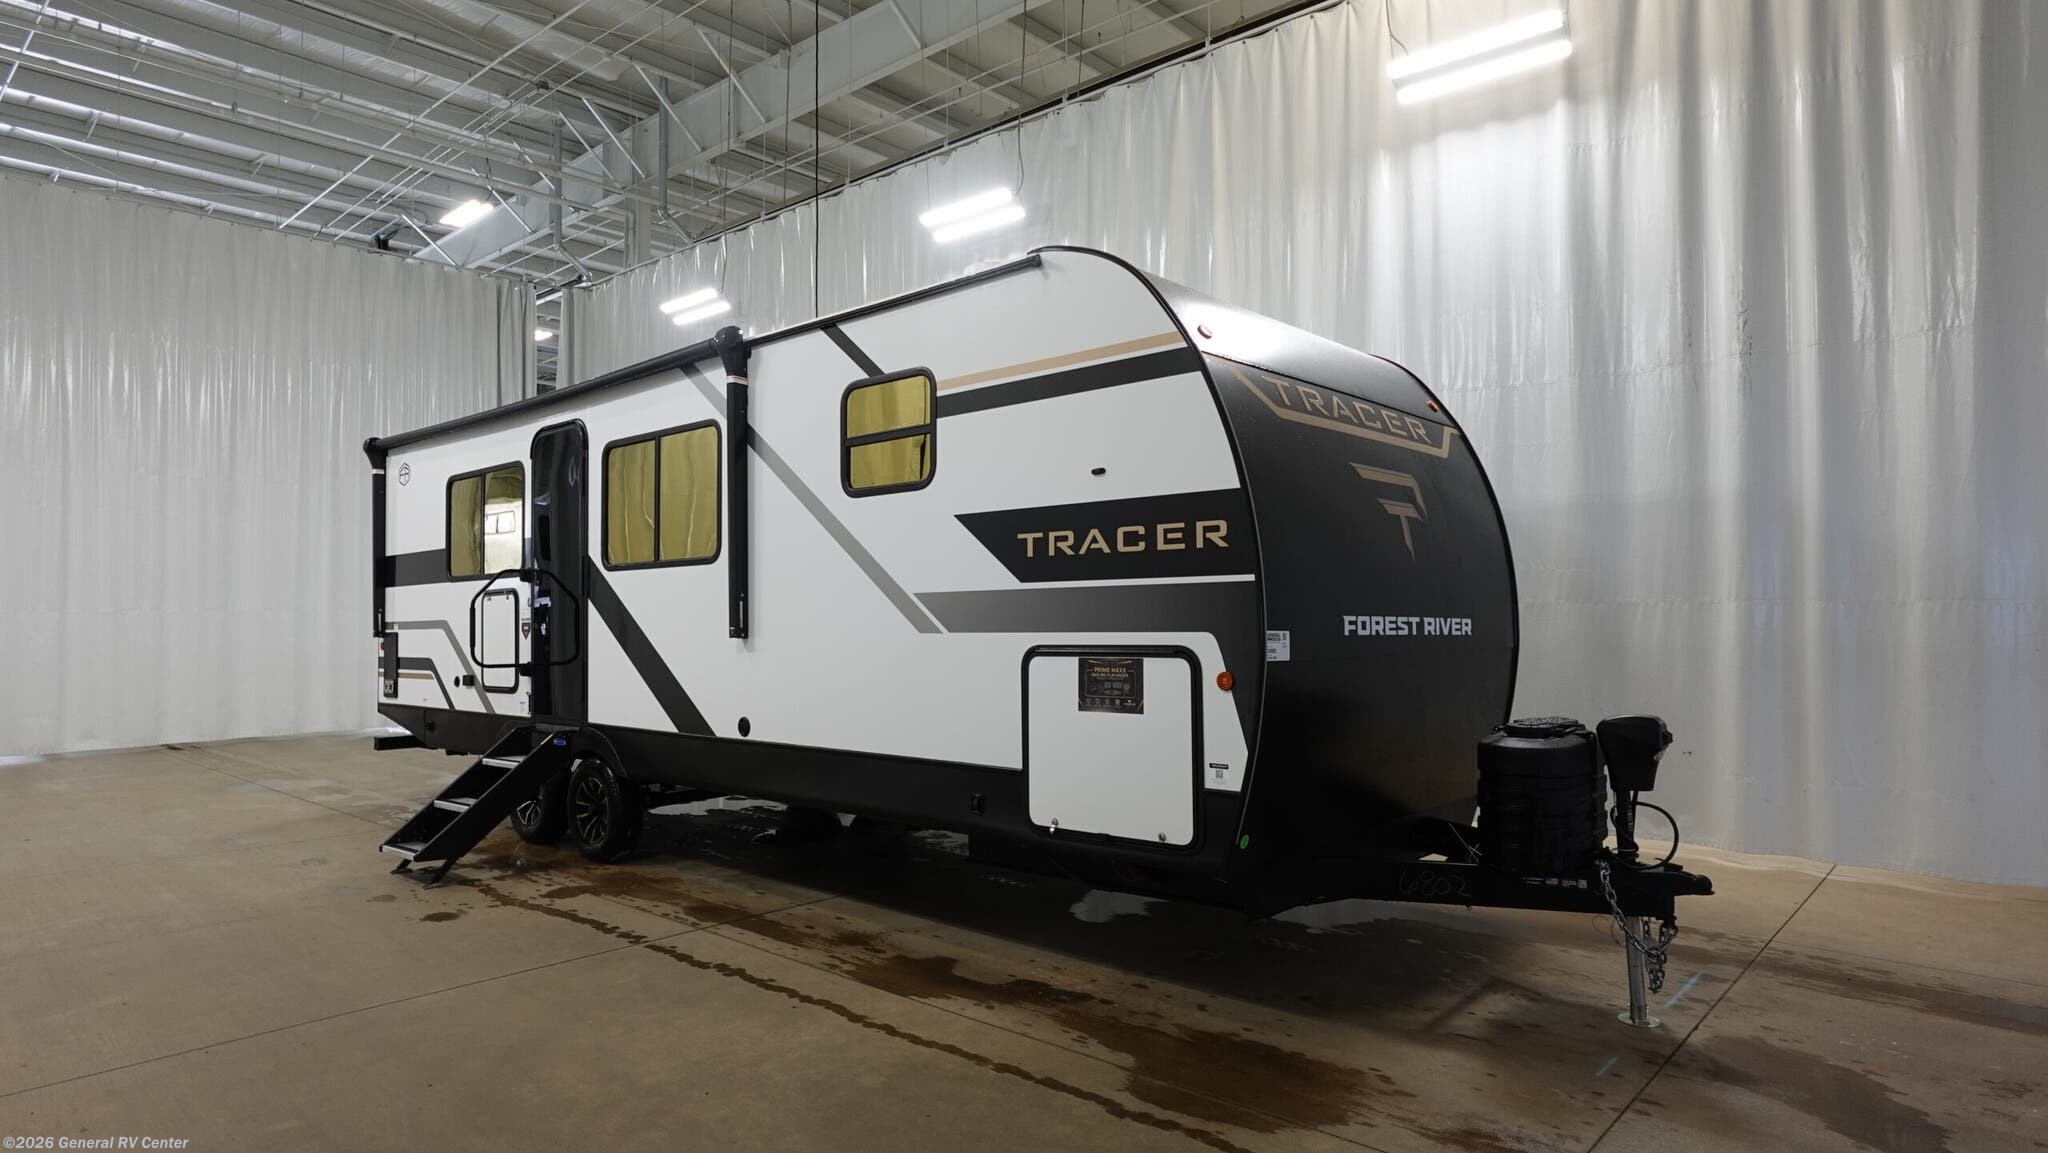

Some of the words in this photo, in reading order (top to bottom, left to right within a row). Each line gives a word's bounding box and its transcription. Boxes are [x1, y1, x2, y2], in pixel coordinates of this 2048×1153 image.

[1262, 375, 1432, 443] TRACER
[1017, 519, 1229, 558] TRACER
[1343, 615, 1420, 636] FOREST
[1423, 616, 1472, 637] RIVER
